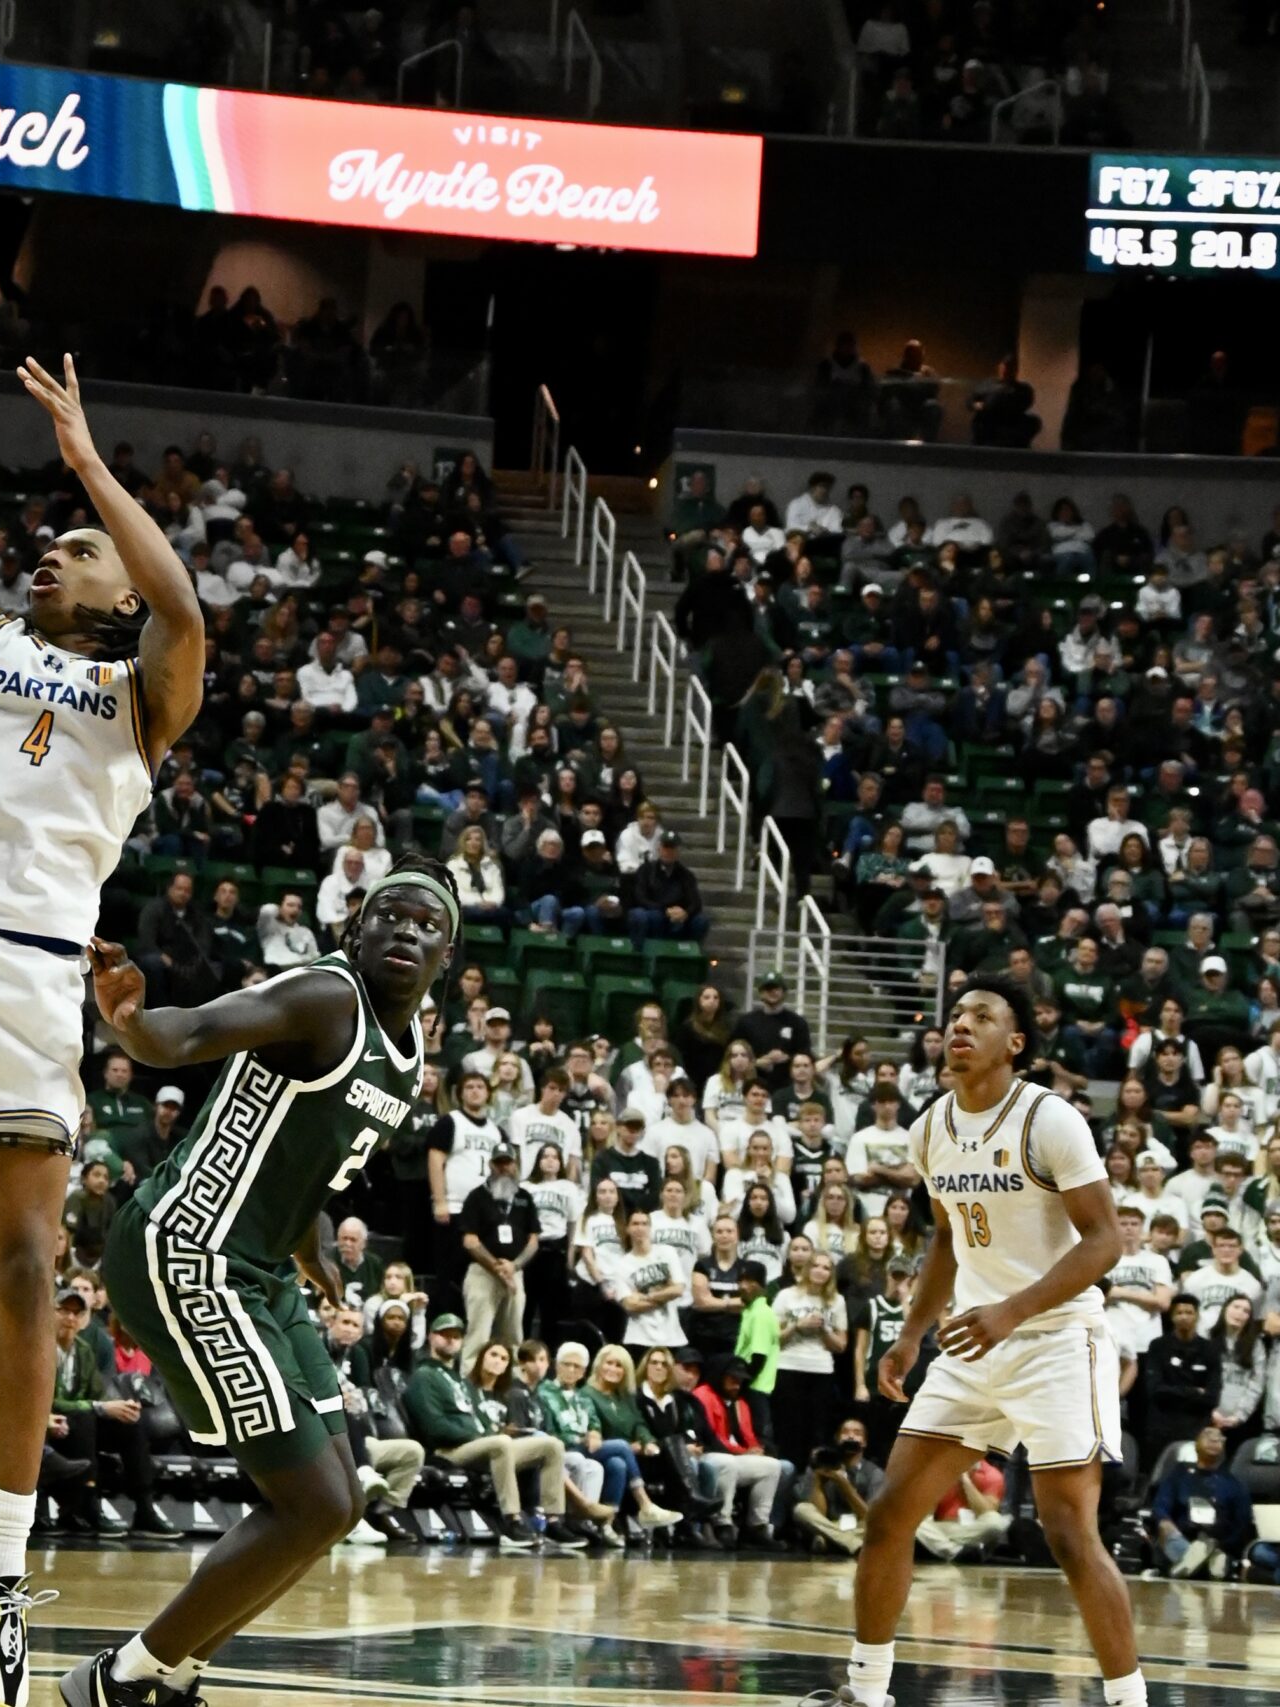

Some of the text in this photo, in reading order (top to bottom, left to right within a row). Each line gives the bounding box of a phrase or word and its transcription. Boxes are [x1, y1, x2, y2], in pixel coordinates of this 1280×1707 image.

[452, 125, 542, 151] VISIT
[328, 149, 661, 225] Myrtle Beach
[1098, 165, 1172, 206] FG%
[1089, 226, 1278, 270] 45.5 20.8
[19, 708, 55, 767] 4
[327, 1126, 380, 1192] 2
[931, 1173, 1025, 1194] SPARTANS
[956, 1201, 993, 1248] 13
